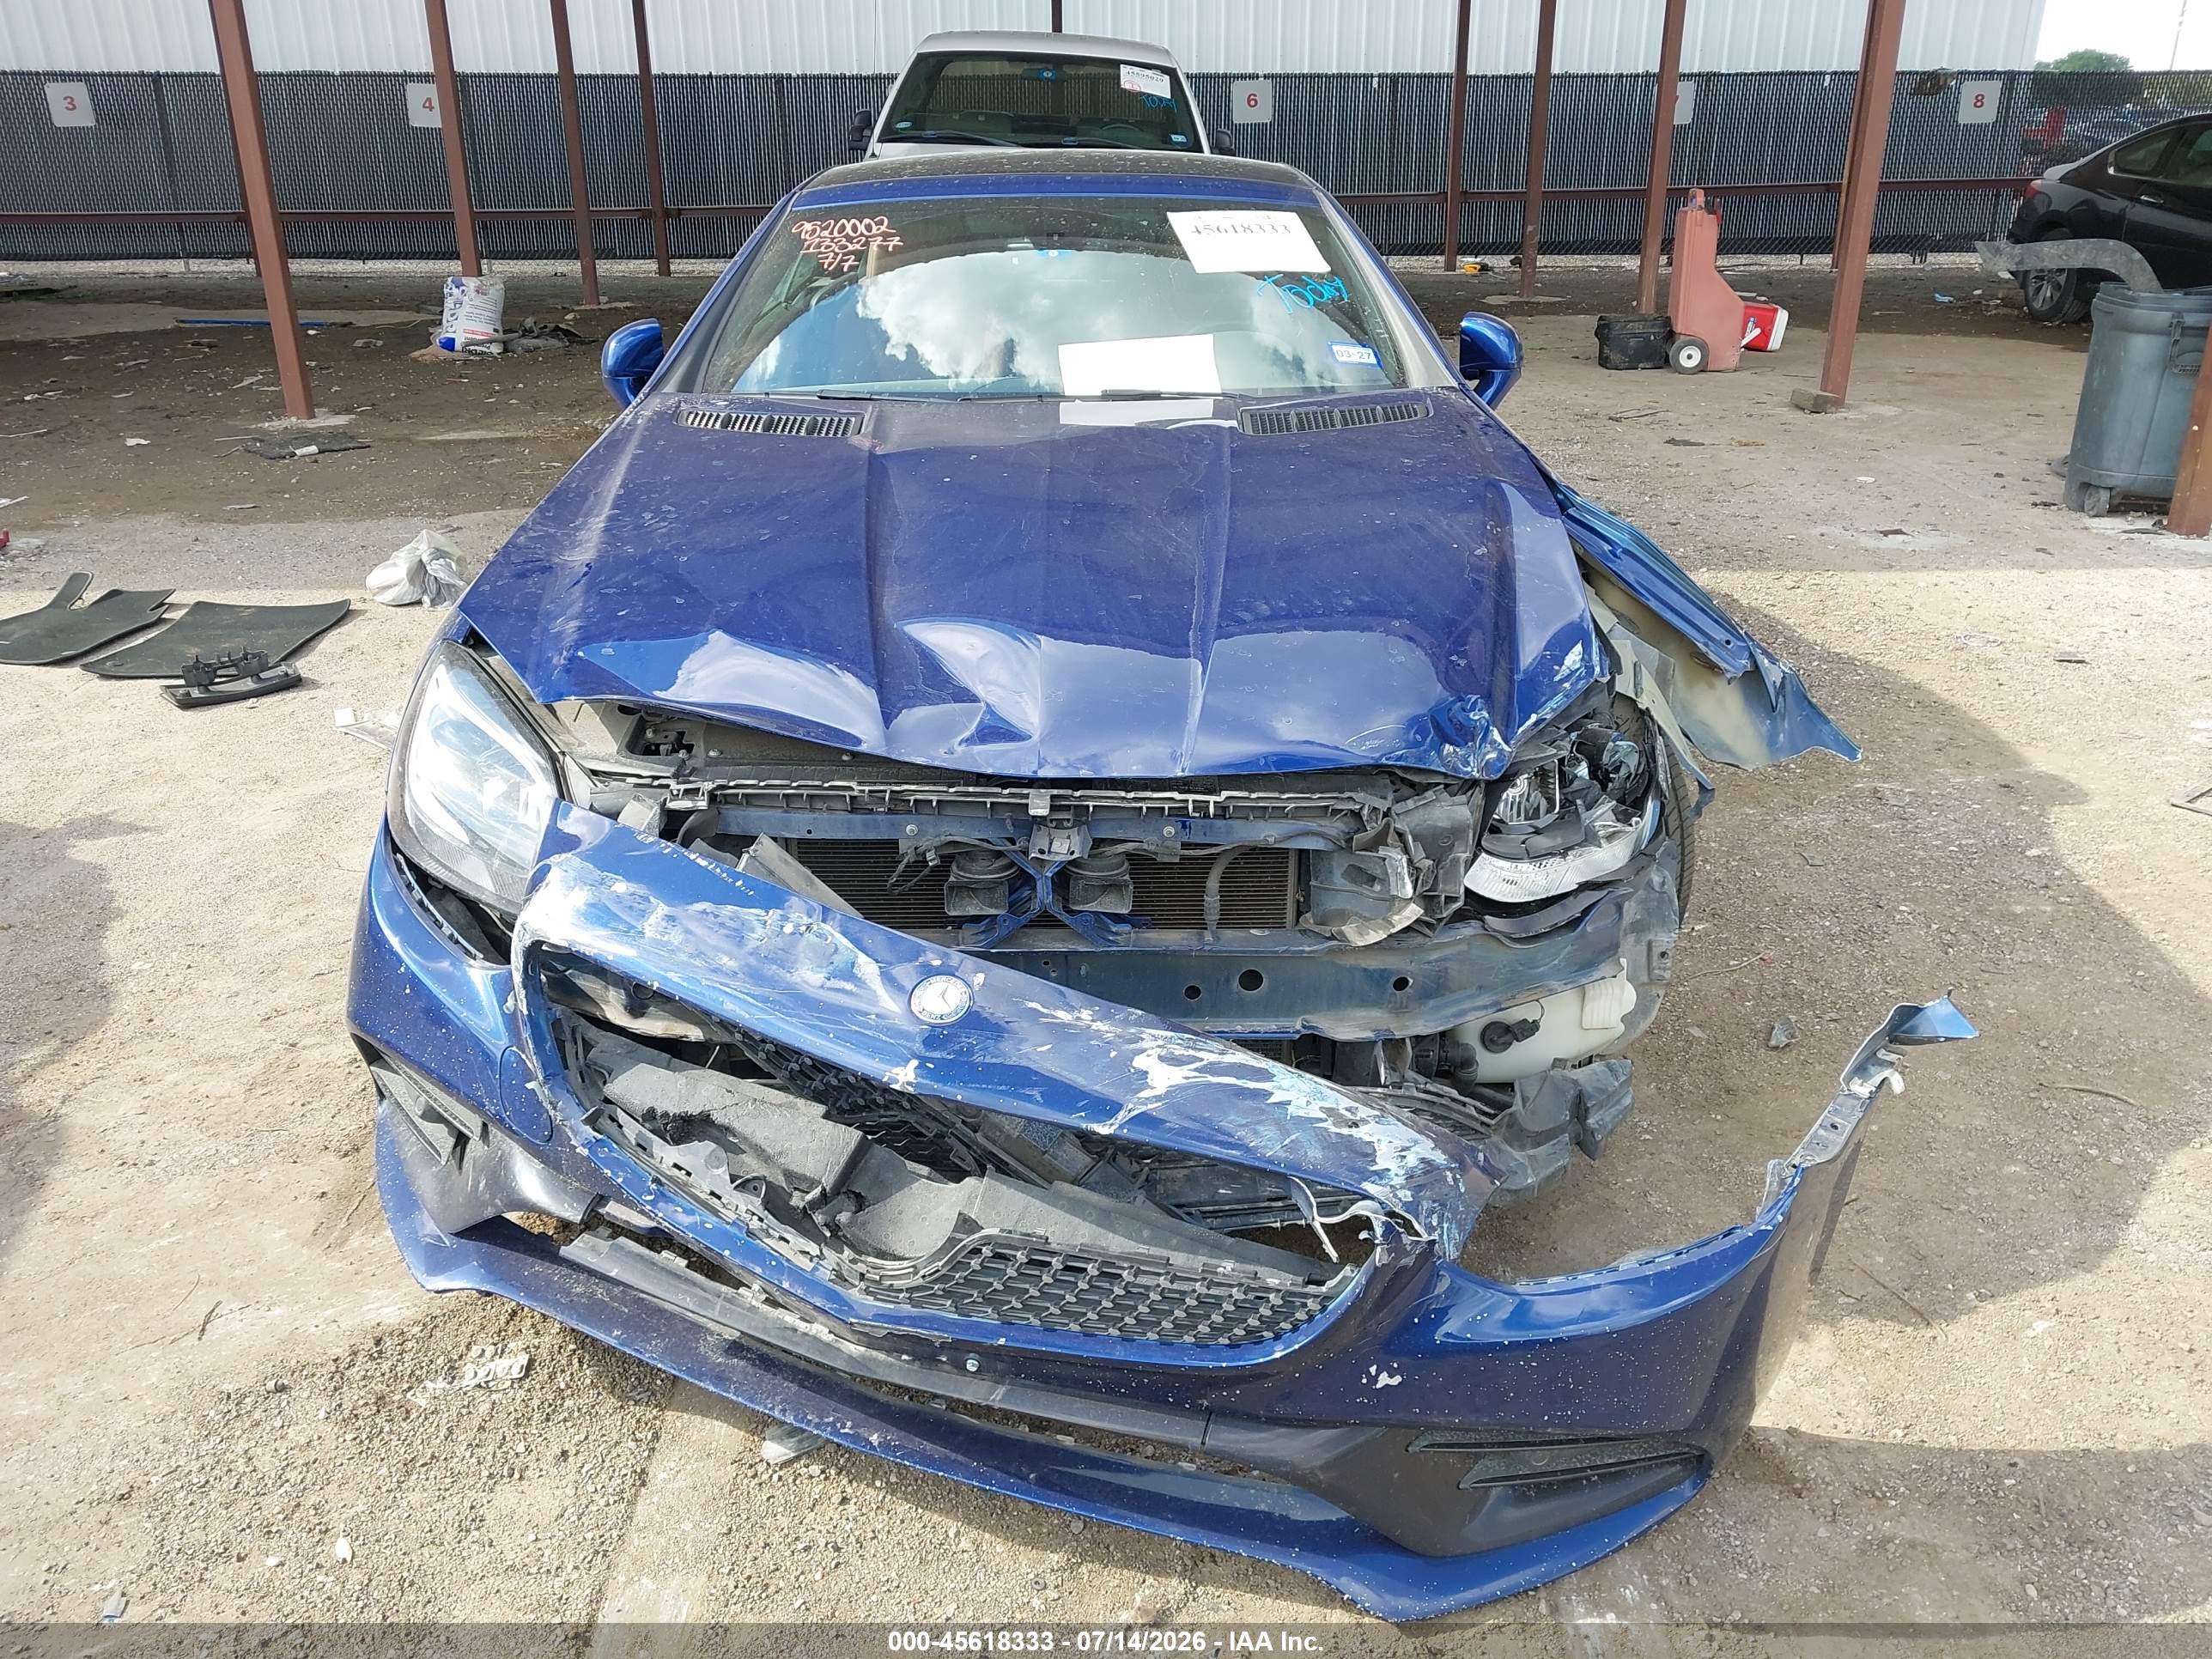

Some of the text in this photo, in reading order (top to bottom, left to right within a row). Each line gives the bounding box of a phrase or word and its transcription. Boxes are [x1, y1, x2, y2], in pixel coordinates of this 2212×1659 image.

[63, 95, 76, 112] 3
[422, 96, 435, 112] 4
[1246, 93, 1258, 108] 6
[1973, 94, 1985, 108] 8
[791, 216, 896, 240] 9520002
[1191, 223, 1291, 236] 45618333
[817, 252, 860, 272] 7/7
